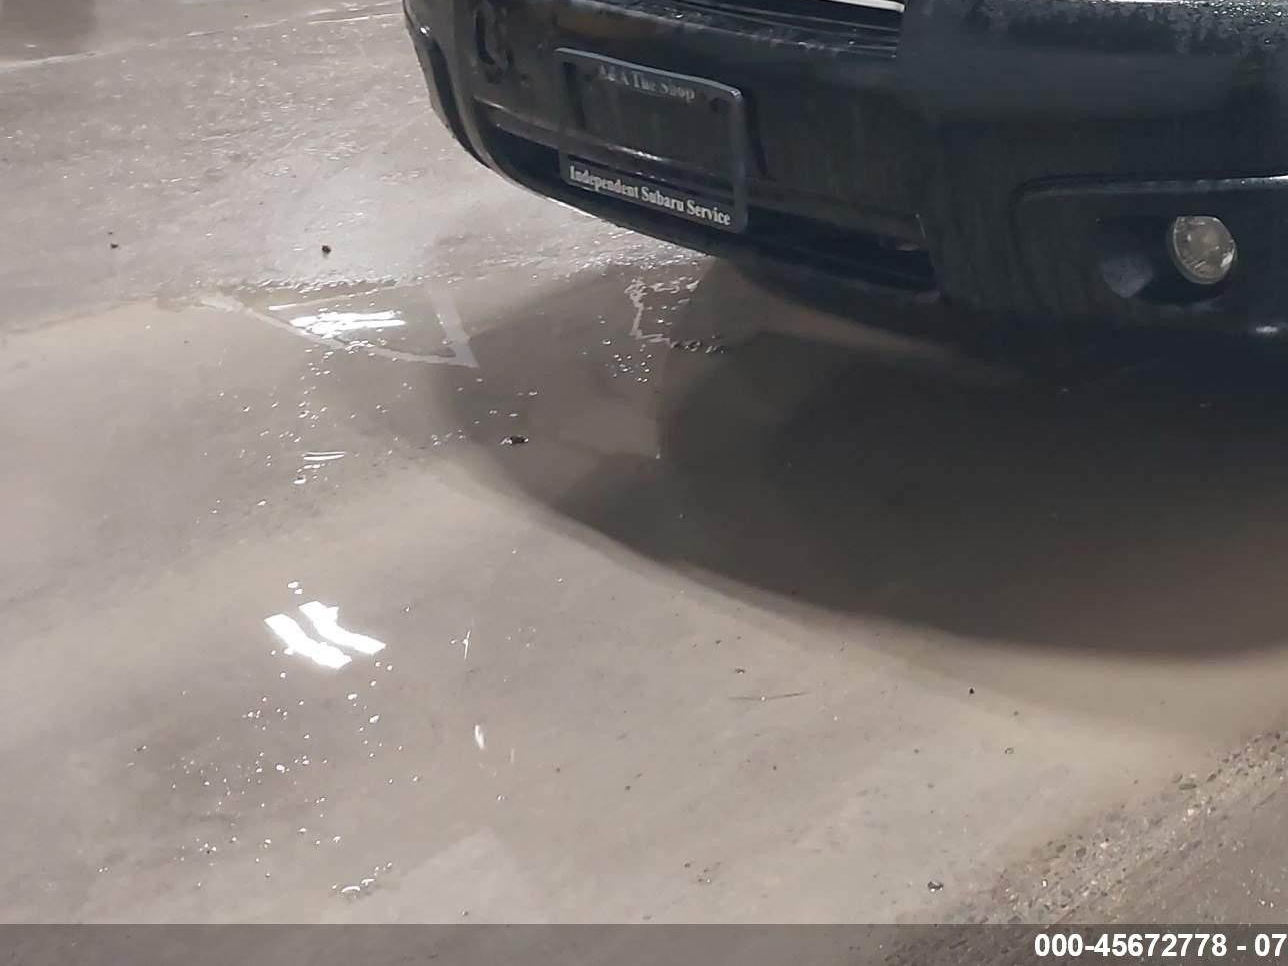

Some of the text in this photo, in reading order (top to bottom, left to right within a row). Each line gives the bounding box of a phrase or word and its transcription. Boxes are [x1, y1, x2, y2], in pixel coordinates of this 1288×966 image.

[569, 165, 732, 226] Independent Subaru Service
